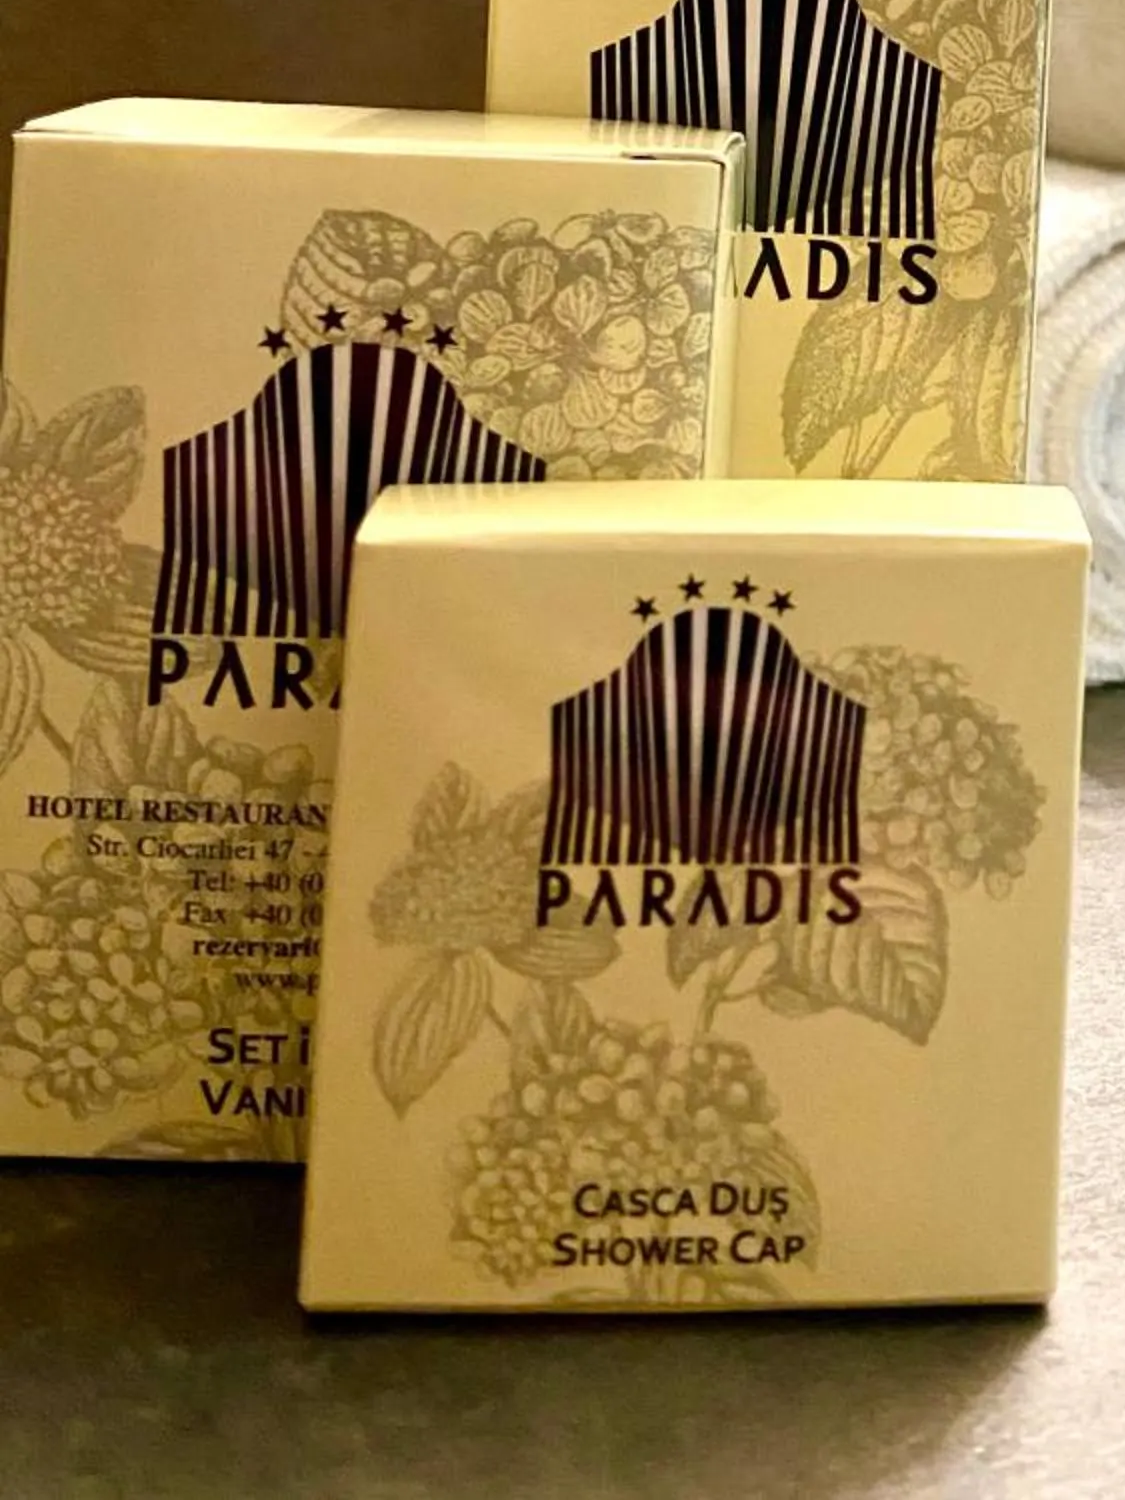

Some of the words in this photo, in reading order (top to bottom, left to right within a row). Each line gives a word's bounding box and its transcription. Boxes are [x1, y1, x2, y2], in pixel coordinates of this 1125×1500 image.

[147, 638, 341, 710] PAR
[28, 795, 132, 821] HOTEL
[142, 800, 333, 826] RESTAURAN
[265, 839, 295, 862] 47
[245, 871, 291, 893] +40
[535, 867, 863, 927] PARADIS
[193, 936, 321, 957] rezervari
[208, 1027, 289, 1066] SET
[574, 1182, 699, 1219] CASCA
[552, 1232, 720, 1267] SHOWER
[729, 1230, 806, 1265] CAP
